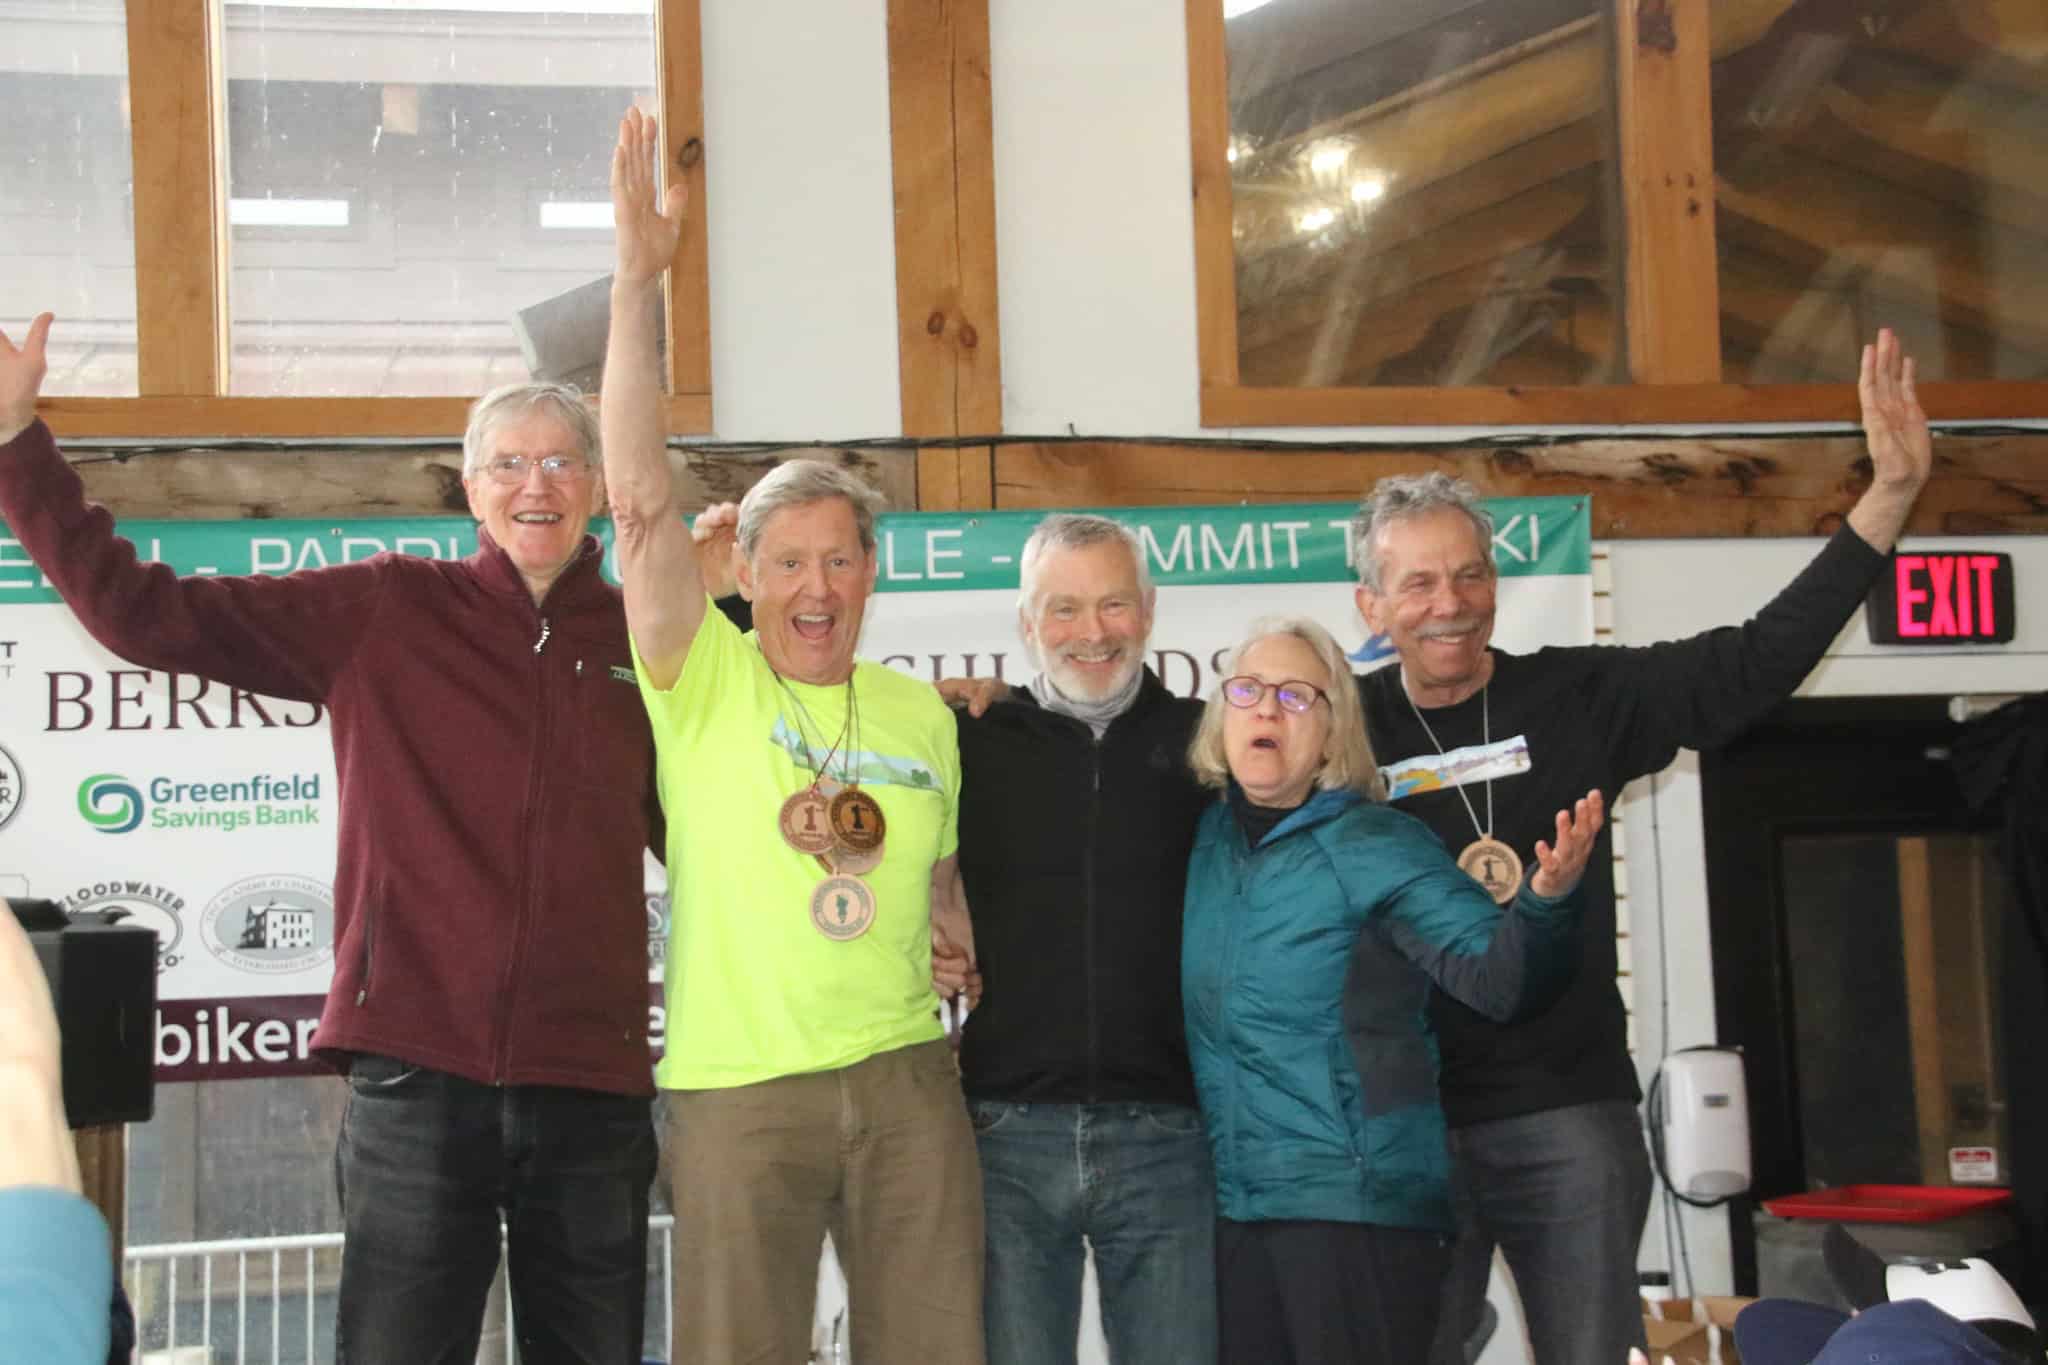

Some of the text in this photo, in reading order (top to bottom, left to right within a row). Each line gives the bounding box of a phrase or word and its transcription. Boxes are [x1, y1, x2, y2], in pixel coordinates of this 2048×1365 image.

[1896, 555, 1999, 637] EXIT
[150, 773, 320, 804] Greenfield
[151, 803, 320, 832] Savings Bank
[64, 880, 185, 912] LOODWATER
